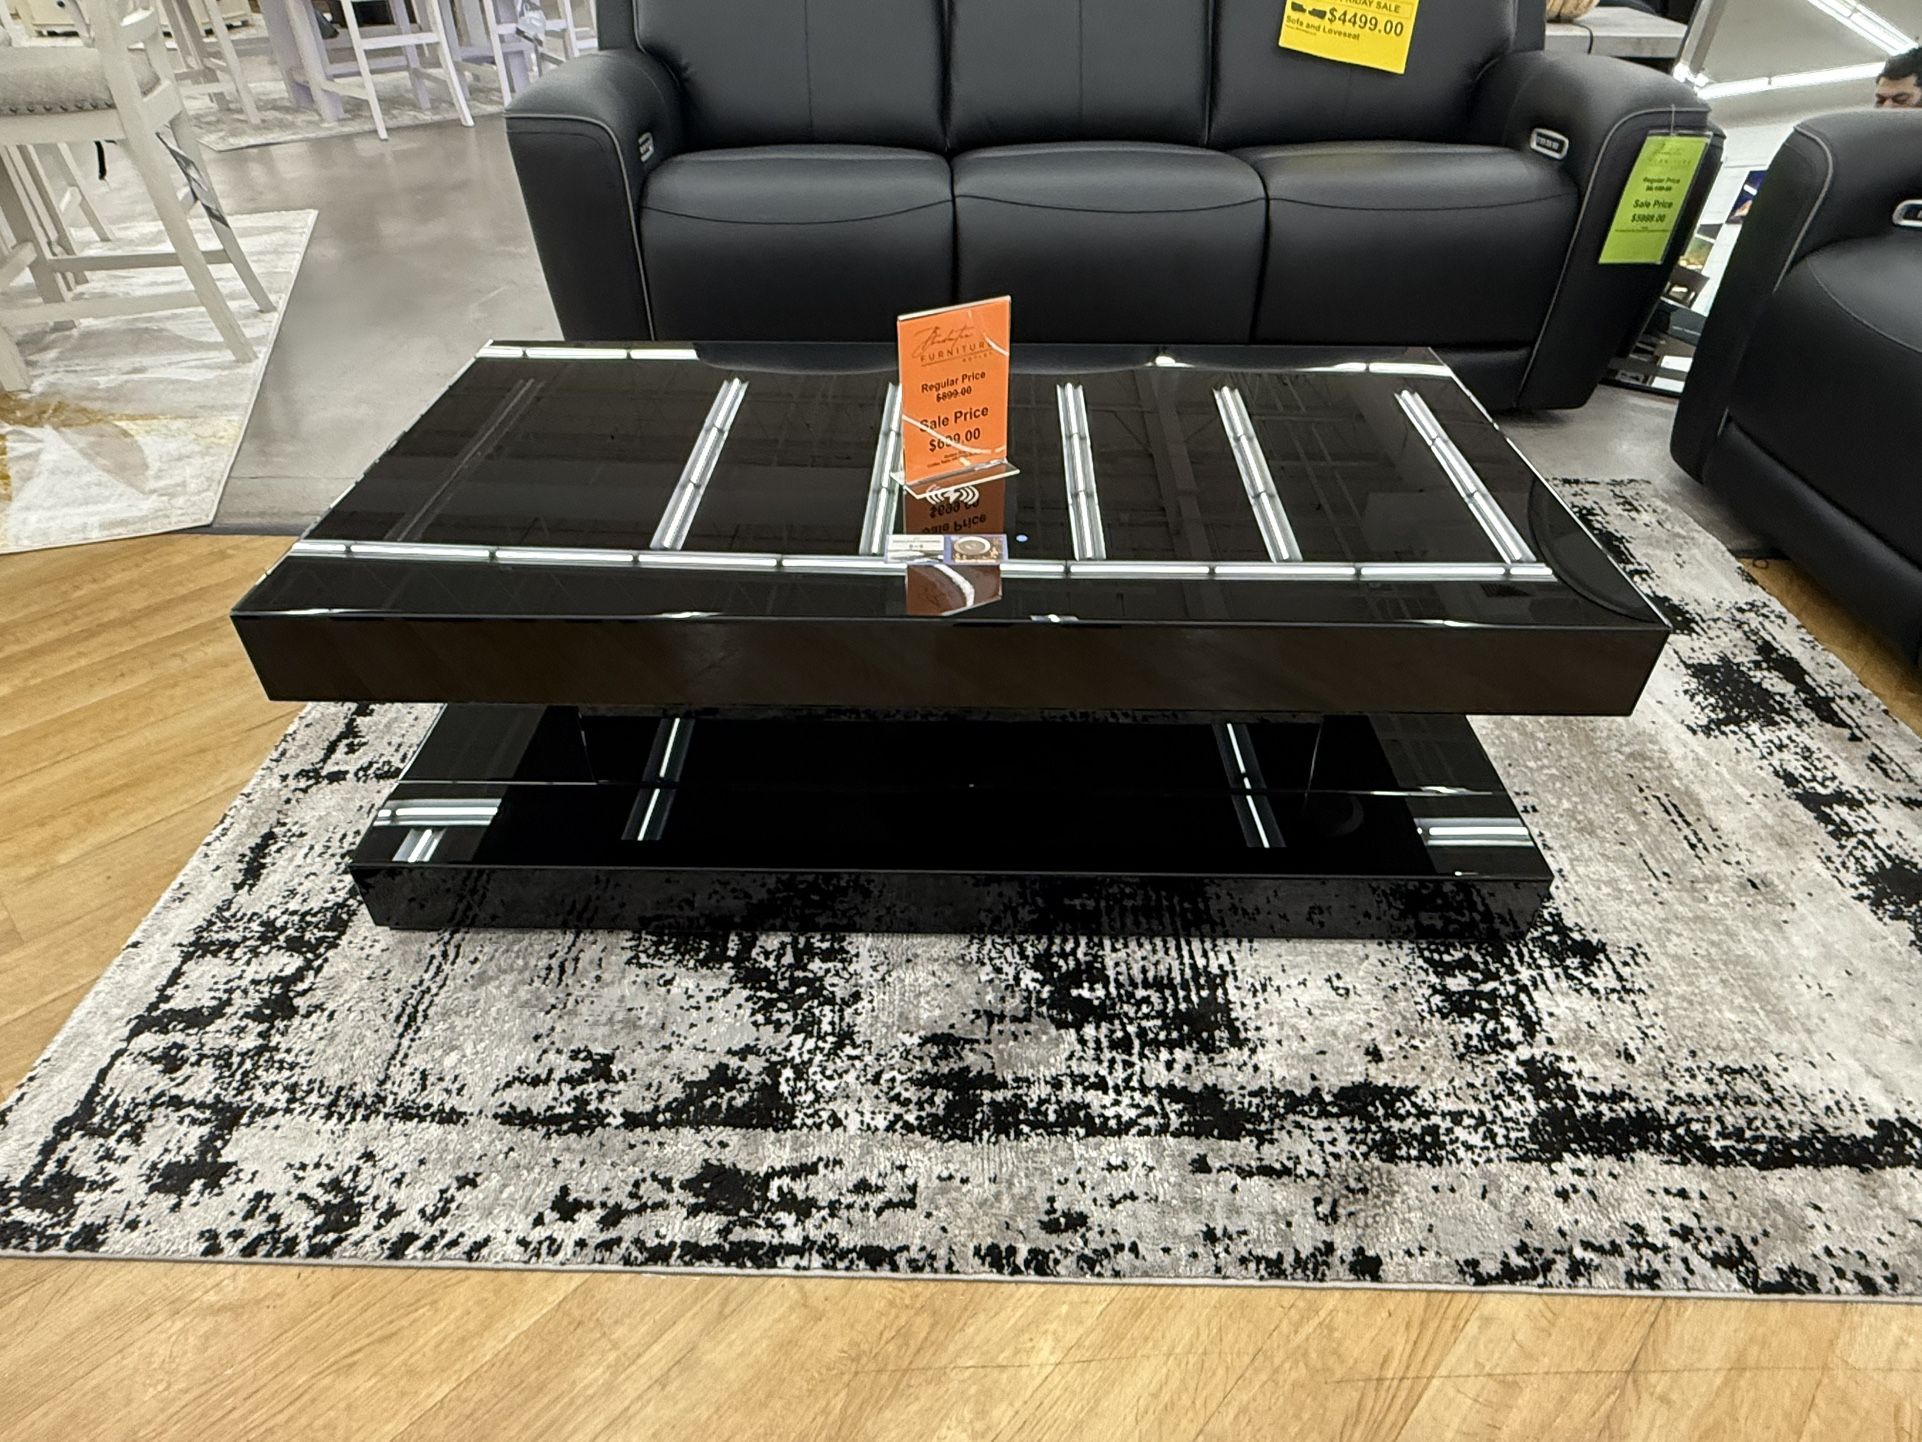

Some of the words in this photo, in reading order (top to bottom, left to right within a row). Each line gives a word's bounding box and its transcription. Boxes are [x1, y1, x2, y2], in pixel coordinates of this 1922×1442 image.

[1340, 0, 1374, 8] DAY
[1375, 1, 1401, 14] SALE
[1286, 15, 1304, 29] Sofa
[1305, 22, 1321, 32] and
[1322, 24, 1360, 41] Loveseat
[1327, 7, 1404, 37] $4499.00
[1633, 199, 1651, 209] Sale
[1653, 199, 1674, 209] Price
[921, 377, 959, 394] Regular
[961, 371, 986, 384] Price
[919, 415, 949, 433] Sale
[954, 406, 989, 424] Price
